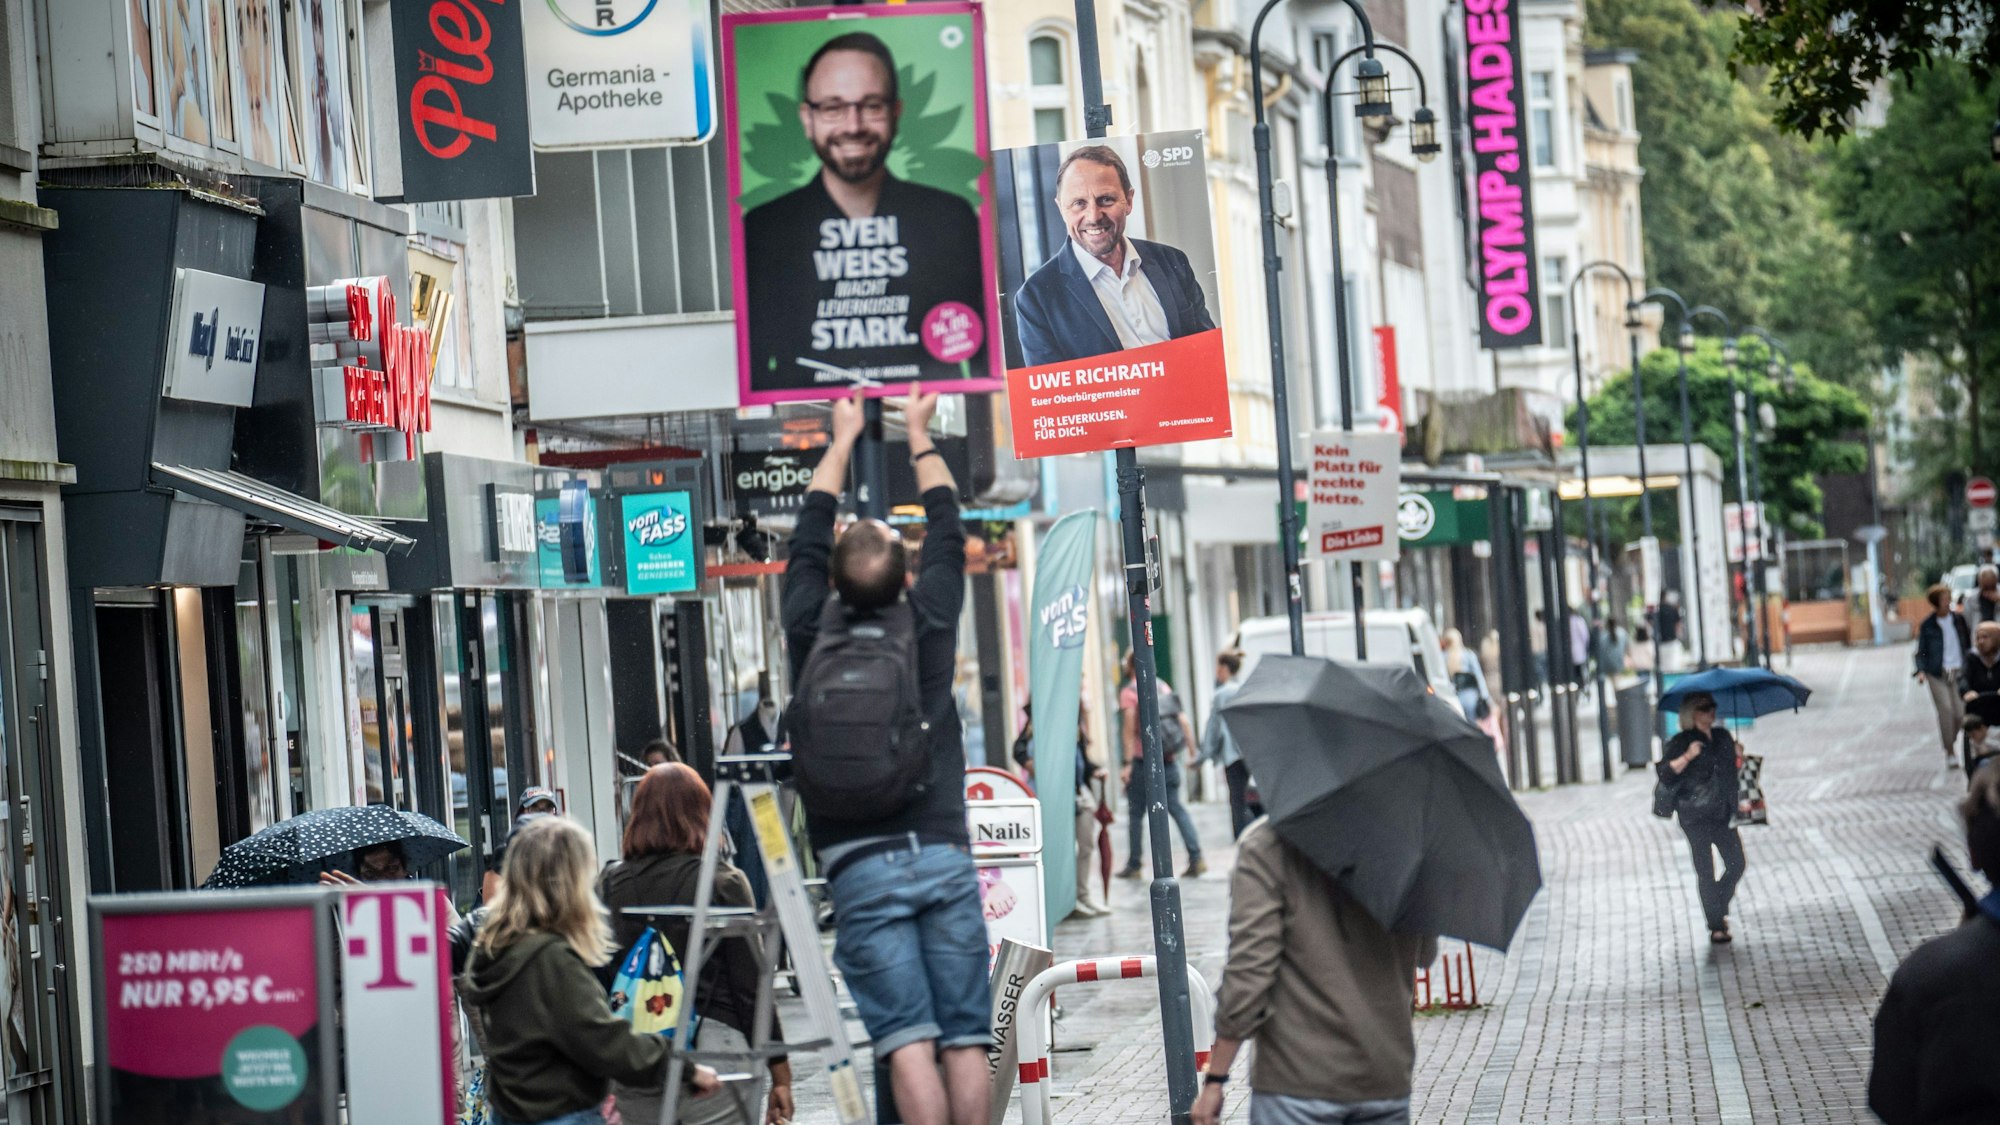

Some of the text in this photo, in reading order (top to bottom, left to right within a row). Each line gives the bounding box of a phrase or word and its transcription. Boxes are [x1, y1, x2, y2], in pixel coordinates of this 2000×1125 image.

[547, 64, 655, 88] Germania
[557, 88, 662, 115] Apotheke
[1162, 146, 1193, 161] SPD
[819, 215, 899, 249] SVEN
[813, 246, 909, 281] WEISS
[811, 315, 919, 350] STARK.
[1028, 361, 1165, 390] UWE RICHRATH
[1031, 387, 1140, 407] Euer Oberbürgermeister
[1033, 409, 1127, 429] FÜR LEVERKUSEN.
[1158, 416, 1214, 427] SPD-LEVERKUSEN.DE
[1035, 426, 1088, 440] FÜR DICH.
[1314, 445, 1350, 457] Kein
[737, 464, 816, 491] engbe
[1313, 461, 1382, 474] Platz für
[1313, 477, 1365, 489] rechte
[1313, 492, 1364, 505] Hetze.
[628, 511, 659, 532] vom
[640, 514, 687, 546] FASS
[1325, 530, 1380, 550] Die Linke
[977, 823, 1031, 841] Nails
[346, 890, 429, 991] T
[119, 951, 162, 975] 250
[121, 979, 184, 1008] NUR
